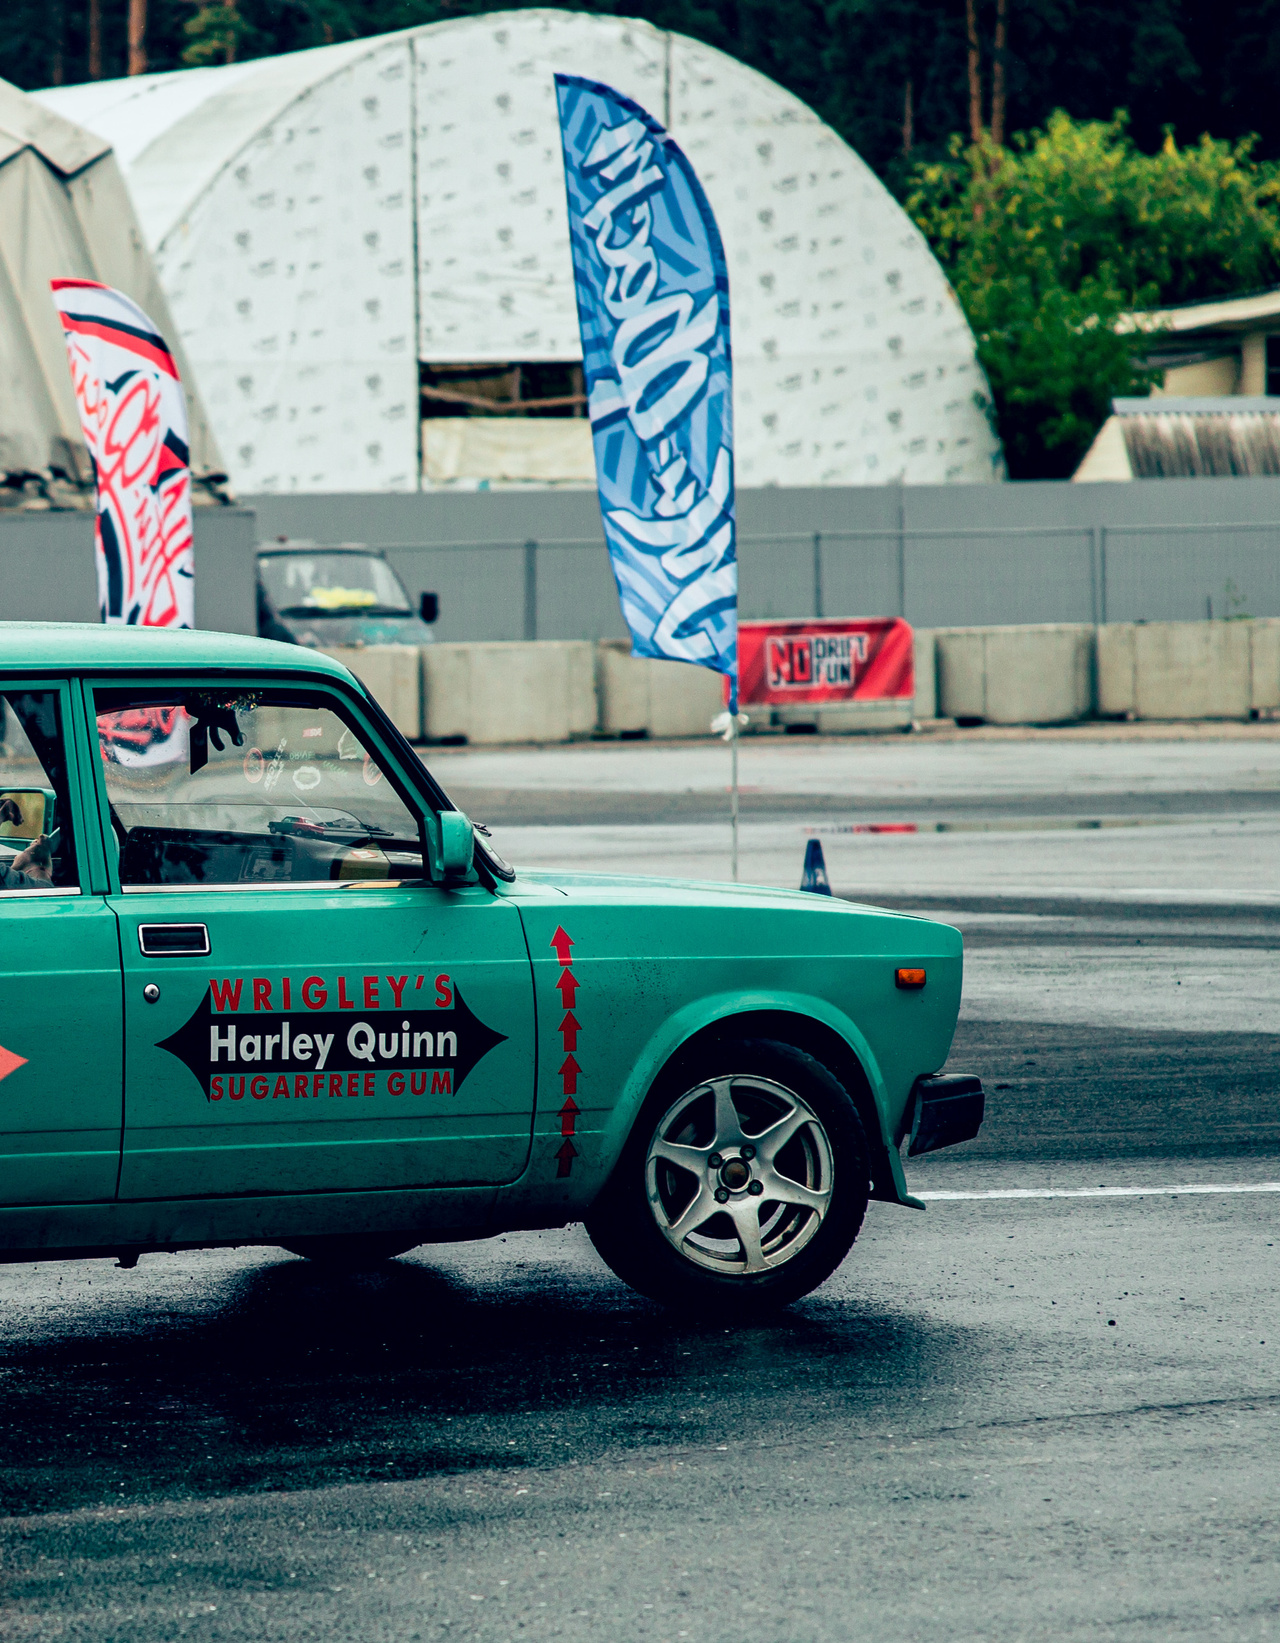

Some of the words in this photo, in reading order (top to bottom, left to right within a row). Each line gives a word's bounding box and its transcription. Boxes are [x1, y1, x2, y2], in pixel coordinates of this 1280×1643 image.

[771, 639, 812, 685] NO
[815, 636, 867, 661] DRIFT
[816, 659, 851, 683] FUN
[209, 974, 453, 1012] WRIGLEY'S
[210, 1021, 335, 1070] Harley
[347, 1020, 457, 1062] Quinn
[210, 1073, 375, 1101] SUGARFREE
[387, 1071, 452, 1096] GUM
